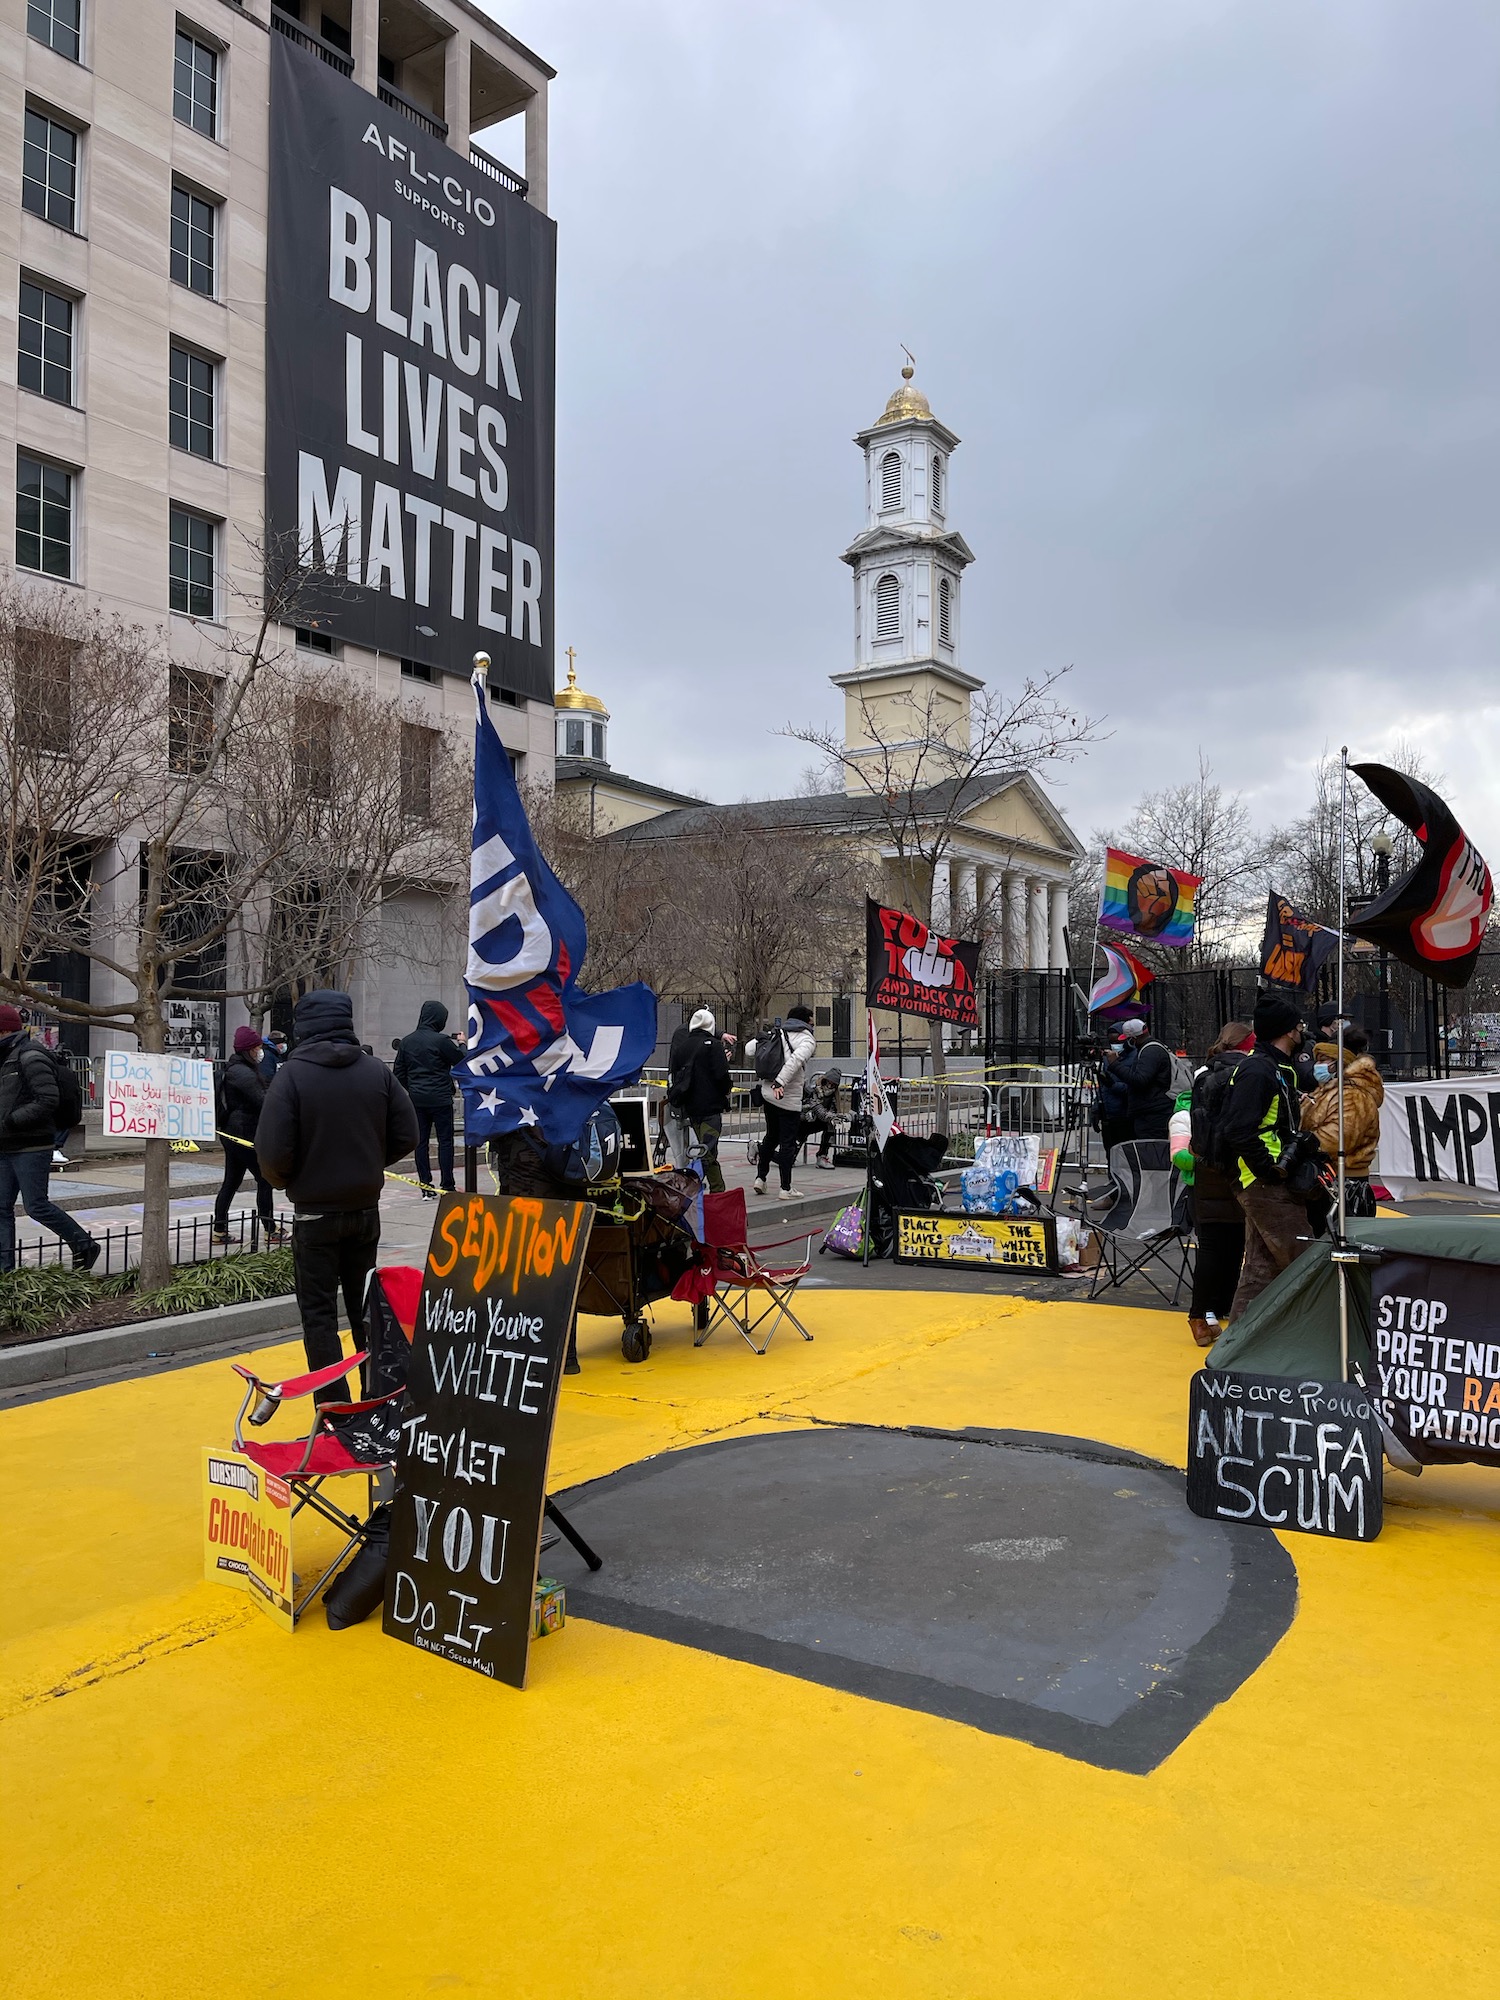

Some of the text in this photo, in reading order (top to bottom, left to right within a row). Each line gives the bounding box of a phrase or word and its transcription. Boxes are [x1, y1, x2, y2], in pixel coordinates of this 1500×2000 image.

[362, 122, 496, 227] AFL-CIO
[394, 179, 466, 236] SUPPORTS
[329, 185, 522, 401] BLACK
[346, 331, 508, 512] LIVES
[299, 450, 542, 647] MATTER
[877, 993, 898, 1006] FOR
[900, 997, 938, 1015] VOTING
[940, 1007, 958, 1020] FOR
[880, 978, 976, 1011] AND FUCK YO
[169, 1057, 211, 1091] BLUE
[168, 1086, 192, 1104] Have
[197, 1092, 208, 1105] to
[109, 1100, 212, 1137] BASH BLUE
[903, 1218, 939, 1232] BLACK
[903, 1232, 943, 1245] SLAVES
[1008, 1225, 1033, 1238] THE
[428, 1197, 586, 1296] SEDITION
[903, 1245, 940, 1258] BUILT
[1001, 1240, 1041, 1253] WHITE
[1003, 1252, 1045, 1265] HOUSE
[425, 1288, 477, 1334] When
[1377, 1294, 1448, 1334] STOP
[427, 1342, 549, 1414] WHITE
[1200, 1375, 1244, 1399] We
[1248, 1385, 1294, 1405] are
[1377, 1364, 1448, 1408] YOUR
[1196, 1405, 1371, 1482] ANTIFA
[1216, 1456, 1365, 1538] SCUM
[413, 1495, 511, 1585] YOU
[266, 1528, 289, 1594] City
[430, 1641, 447, 1656] NOT
